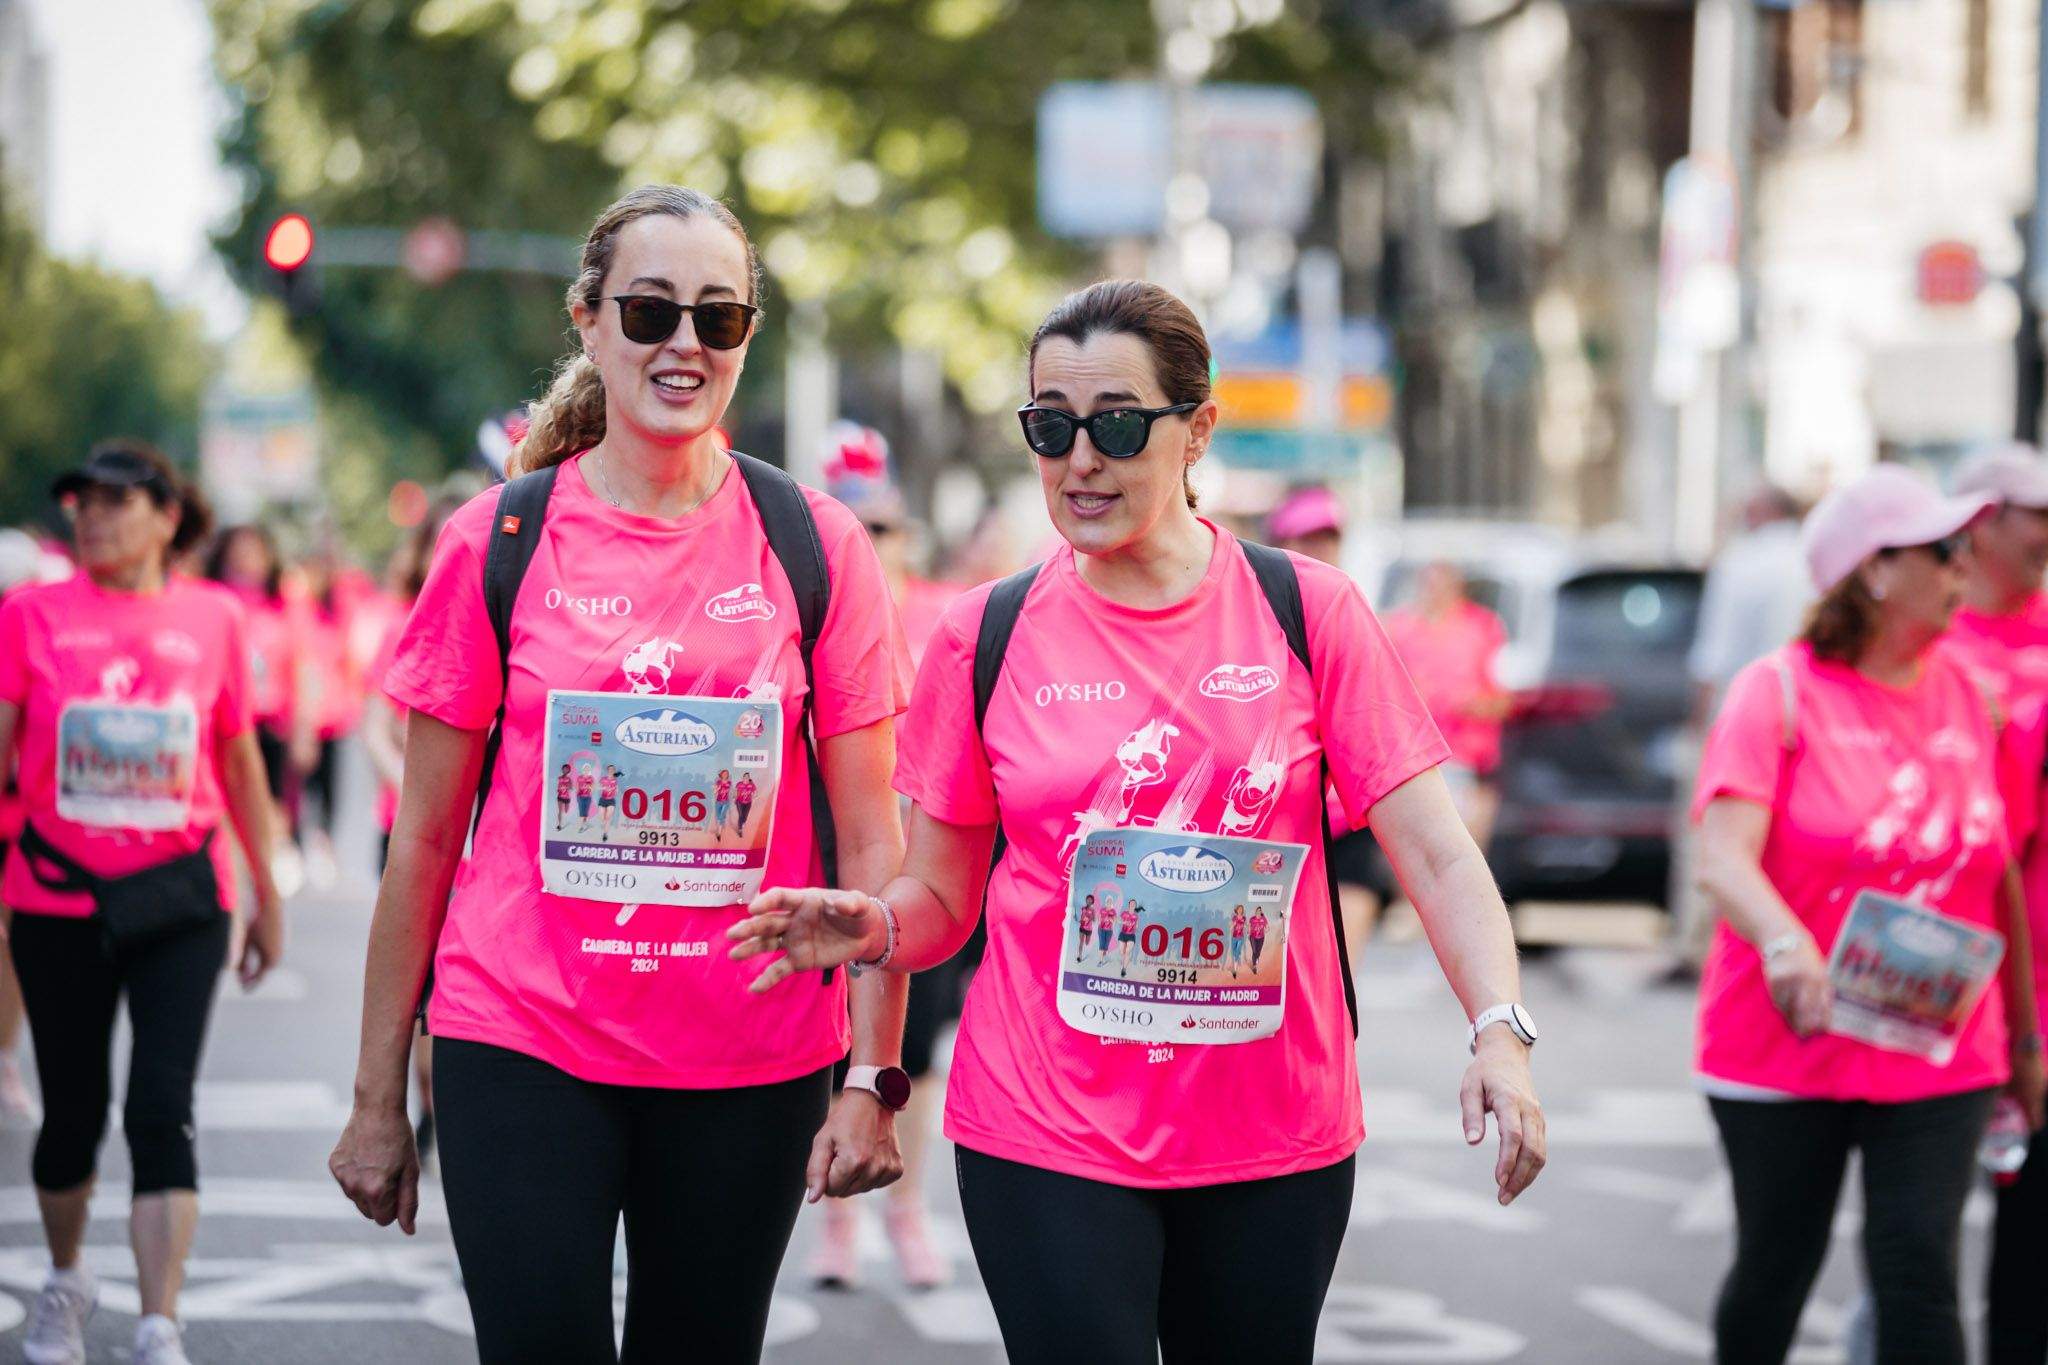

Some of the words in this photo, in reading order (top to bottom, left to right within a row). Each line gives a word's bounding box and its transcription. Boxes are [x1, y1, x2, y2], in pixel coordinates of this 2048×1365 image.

[545, 589, 632, 616] OYSHO
[1035, 681, 1126, 707] OYSHO
[1207, 676, 1274, 693] ASTURIANA
[562, 713, 599, 725] SUMA
[621, 724, 709, 747] ASTURIANA
[621, 787, 707, 823] 016
[639, 830, 680, 847] 9913
[567, 845, 619, 861] CARRERA
[622, 848, 637, 862] DE
[639, 850, 654, 862] LA
[656, 850, 695, 864] MUJER
[703, 851, 747, 865] MADRID
[1087, 846, 1125, 857] SUMA
[566, 869, 637, 890] OYSHO
[1144, 859, 1227, 882] ASTURIANA
[683, 880, 746, 893] Santander
[581, 937, 633, 955] CARRERA
[635, 941, 651, 956] DE
[654, 943, 668, 956] LA
[670, 941, 709, 957] MUJER
[1140, 923, 1225, 961] 016
[631, 958, 660, 973] 2024
[1157, 968, 1198, 985] 9914
[1086, 980, 1136, 998] CARRERA
[1139, 986, 1154, 999] DE
[1156, 987, 1171, 1000] LA
[1174, 987, 1211, 1002] MUJER
[1220, 989, 1260, 1003] MADRID
[1082, 1003, 1154, 1027] OYSHO
[1199, 1017, 1260, 1031] Santander
[1147, 1047, 1175, 1064] 2024
